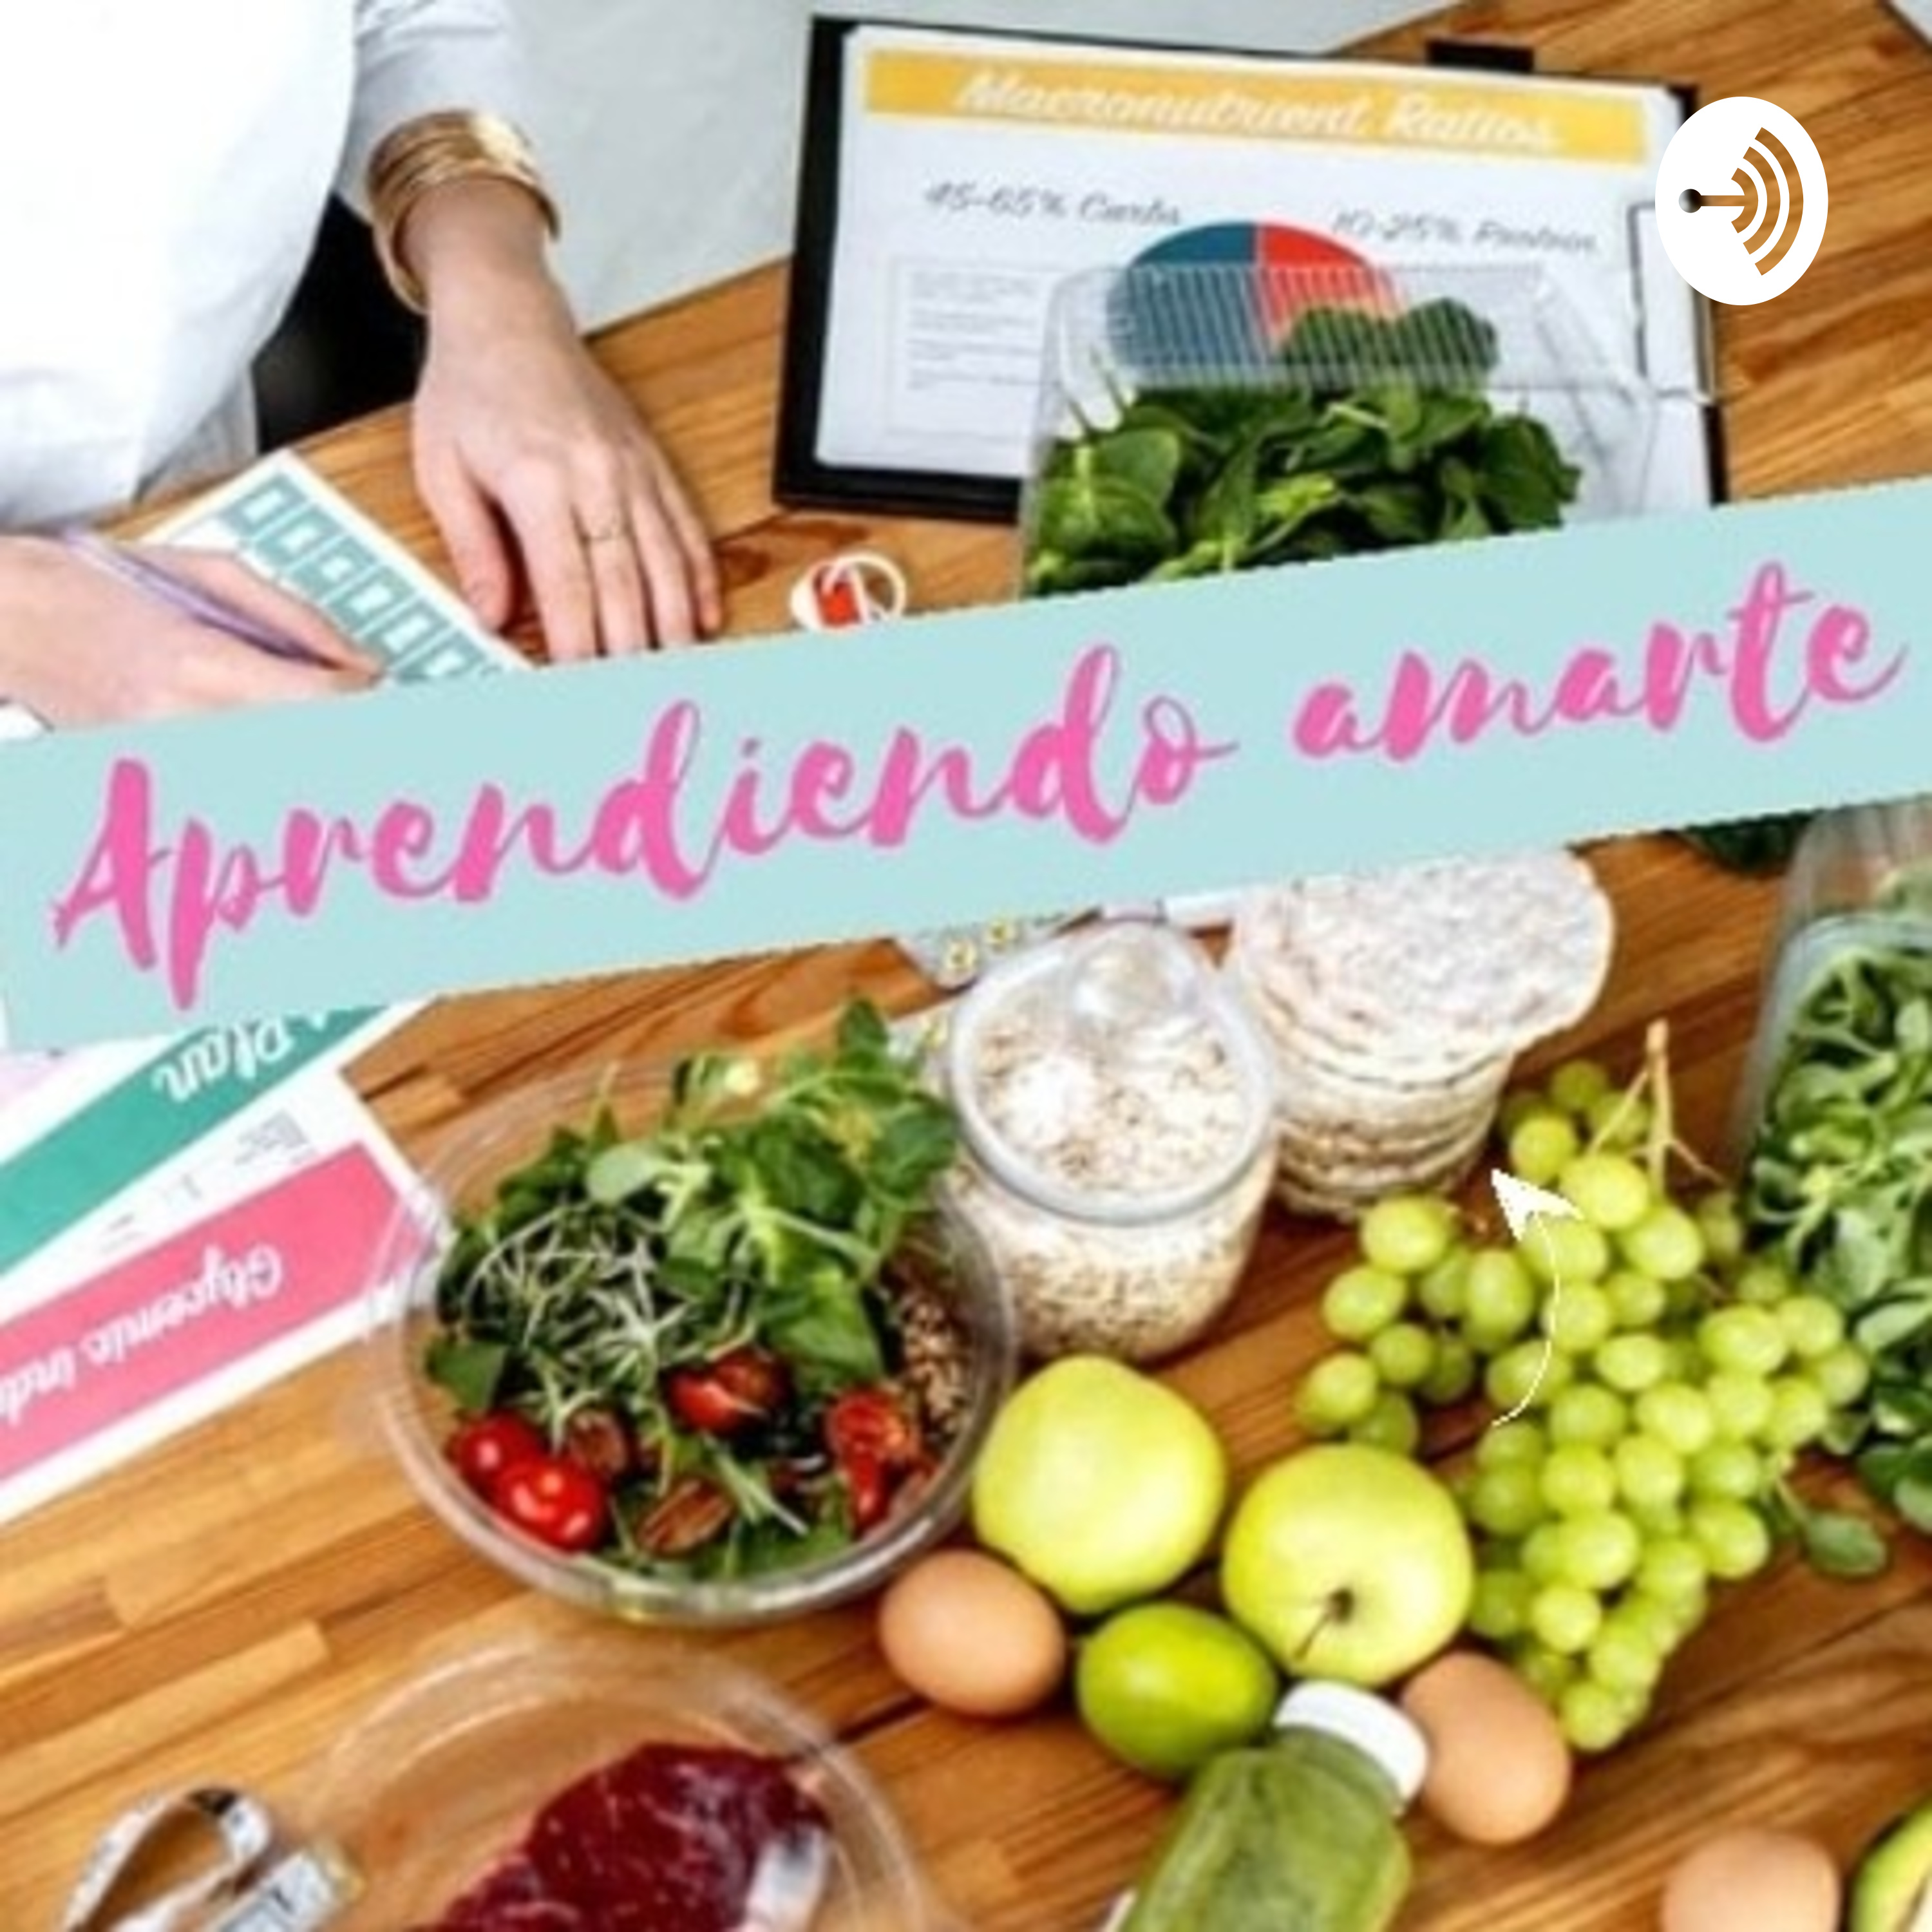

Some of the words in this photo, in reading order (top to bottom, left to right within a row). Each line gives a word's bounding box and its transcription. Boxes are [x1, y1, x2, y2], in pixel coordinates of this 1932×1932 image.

[151, 1019, 294, 1103] Plan
[80, 1243, 283, 1365] Glycemic
[0, 1346, 77, 1426] ind
